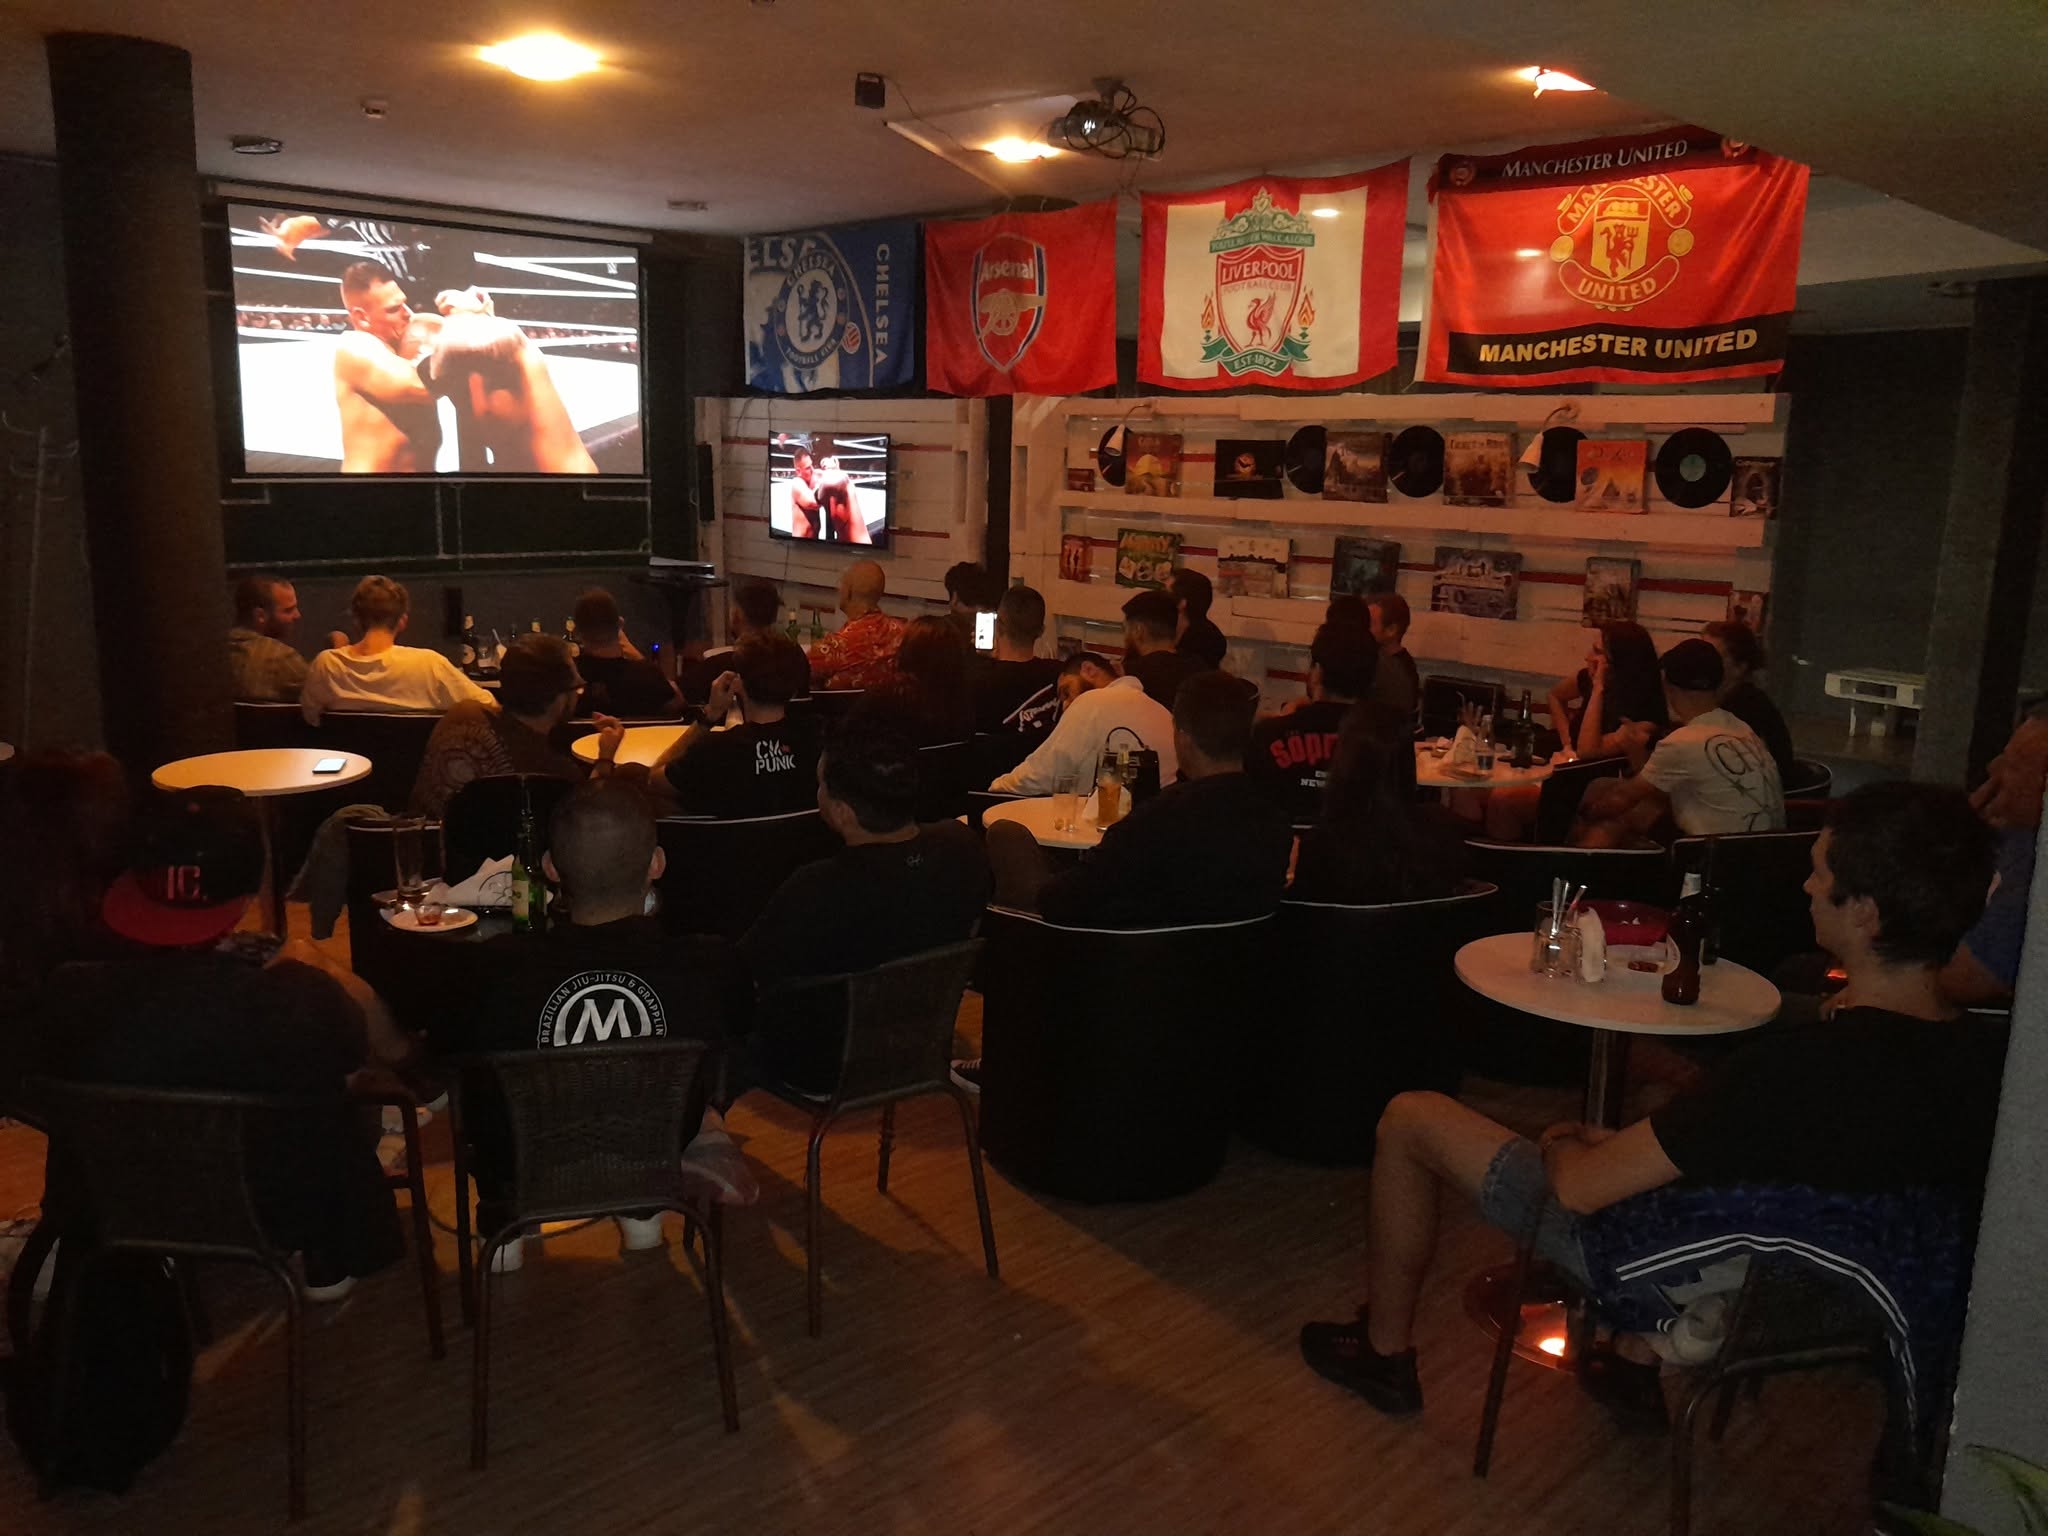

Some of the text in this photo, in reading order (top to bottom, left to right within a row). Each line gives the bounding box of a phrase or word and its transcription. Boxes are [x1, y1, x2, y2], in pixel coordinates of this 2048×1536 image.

[1502, 139, 1688, 177] MANCHESTER UNITED
[980, 258, 1035, 282] Arsenal
[1222, 260, 1297, 281] LIVERPOOL
[875, 243, 890, 364] CHELSEA
[1578, 277, 1657, 301] UNITED
[1479, 328, 1758, 362] MANCHESTER UNITED
[755, 754, 797, 775] PUNK
[541, 986, 571, 1043] BRAZILIAN
[571, 973, 627, 990] JIU-JITSU
[637, 986, 665, 1036] GRAPPLIN
